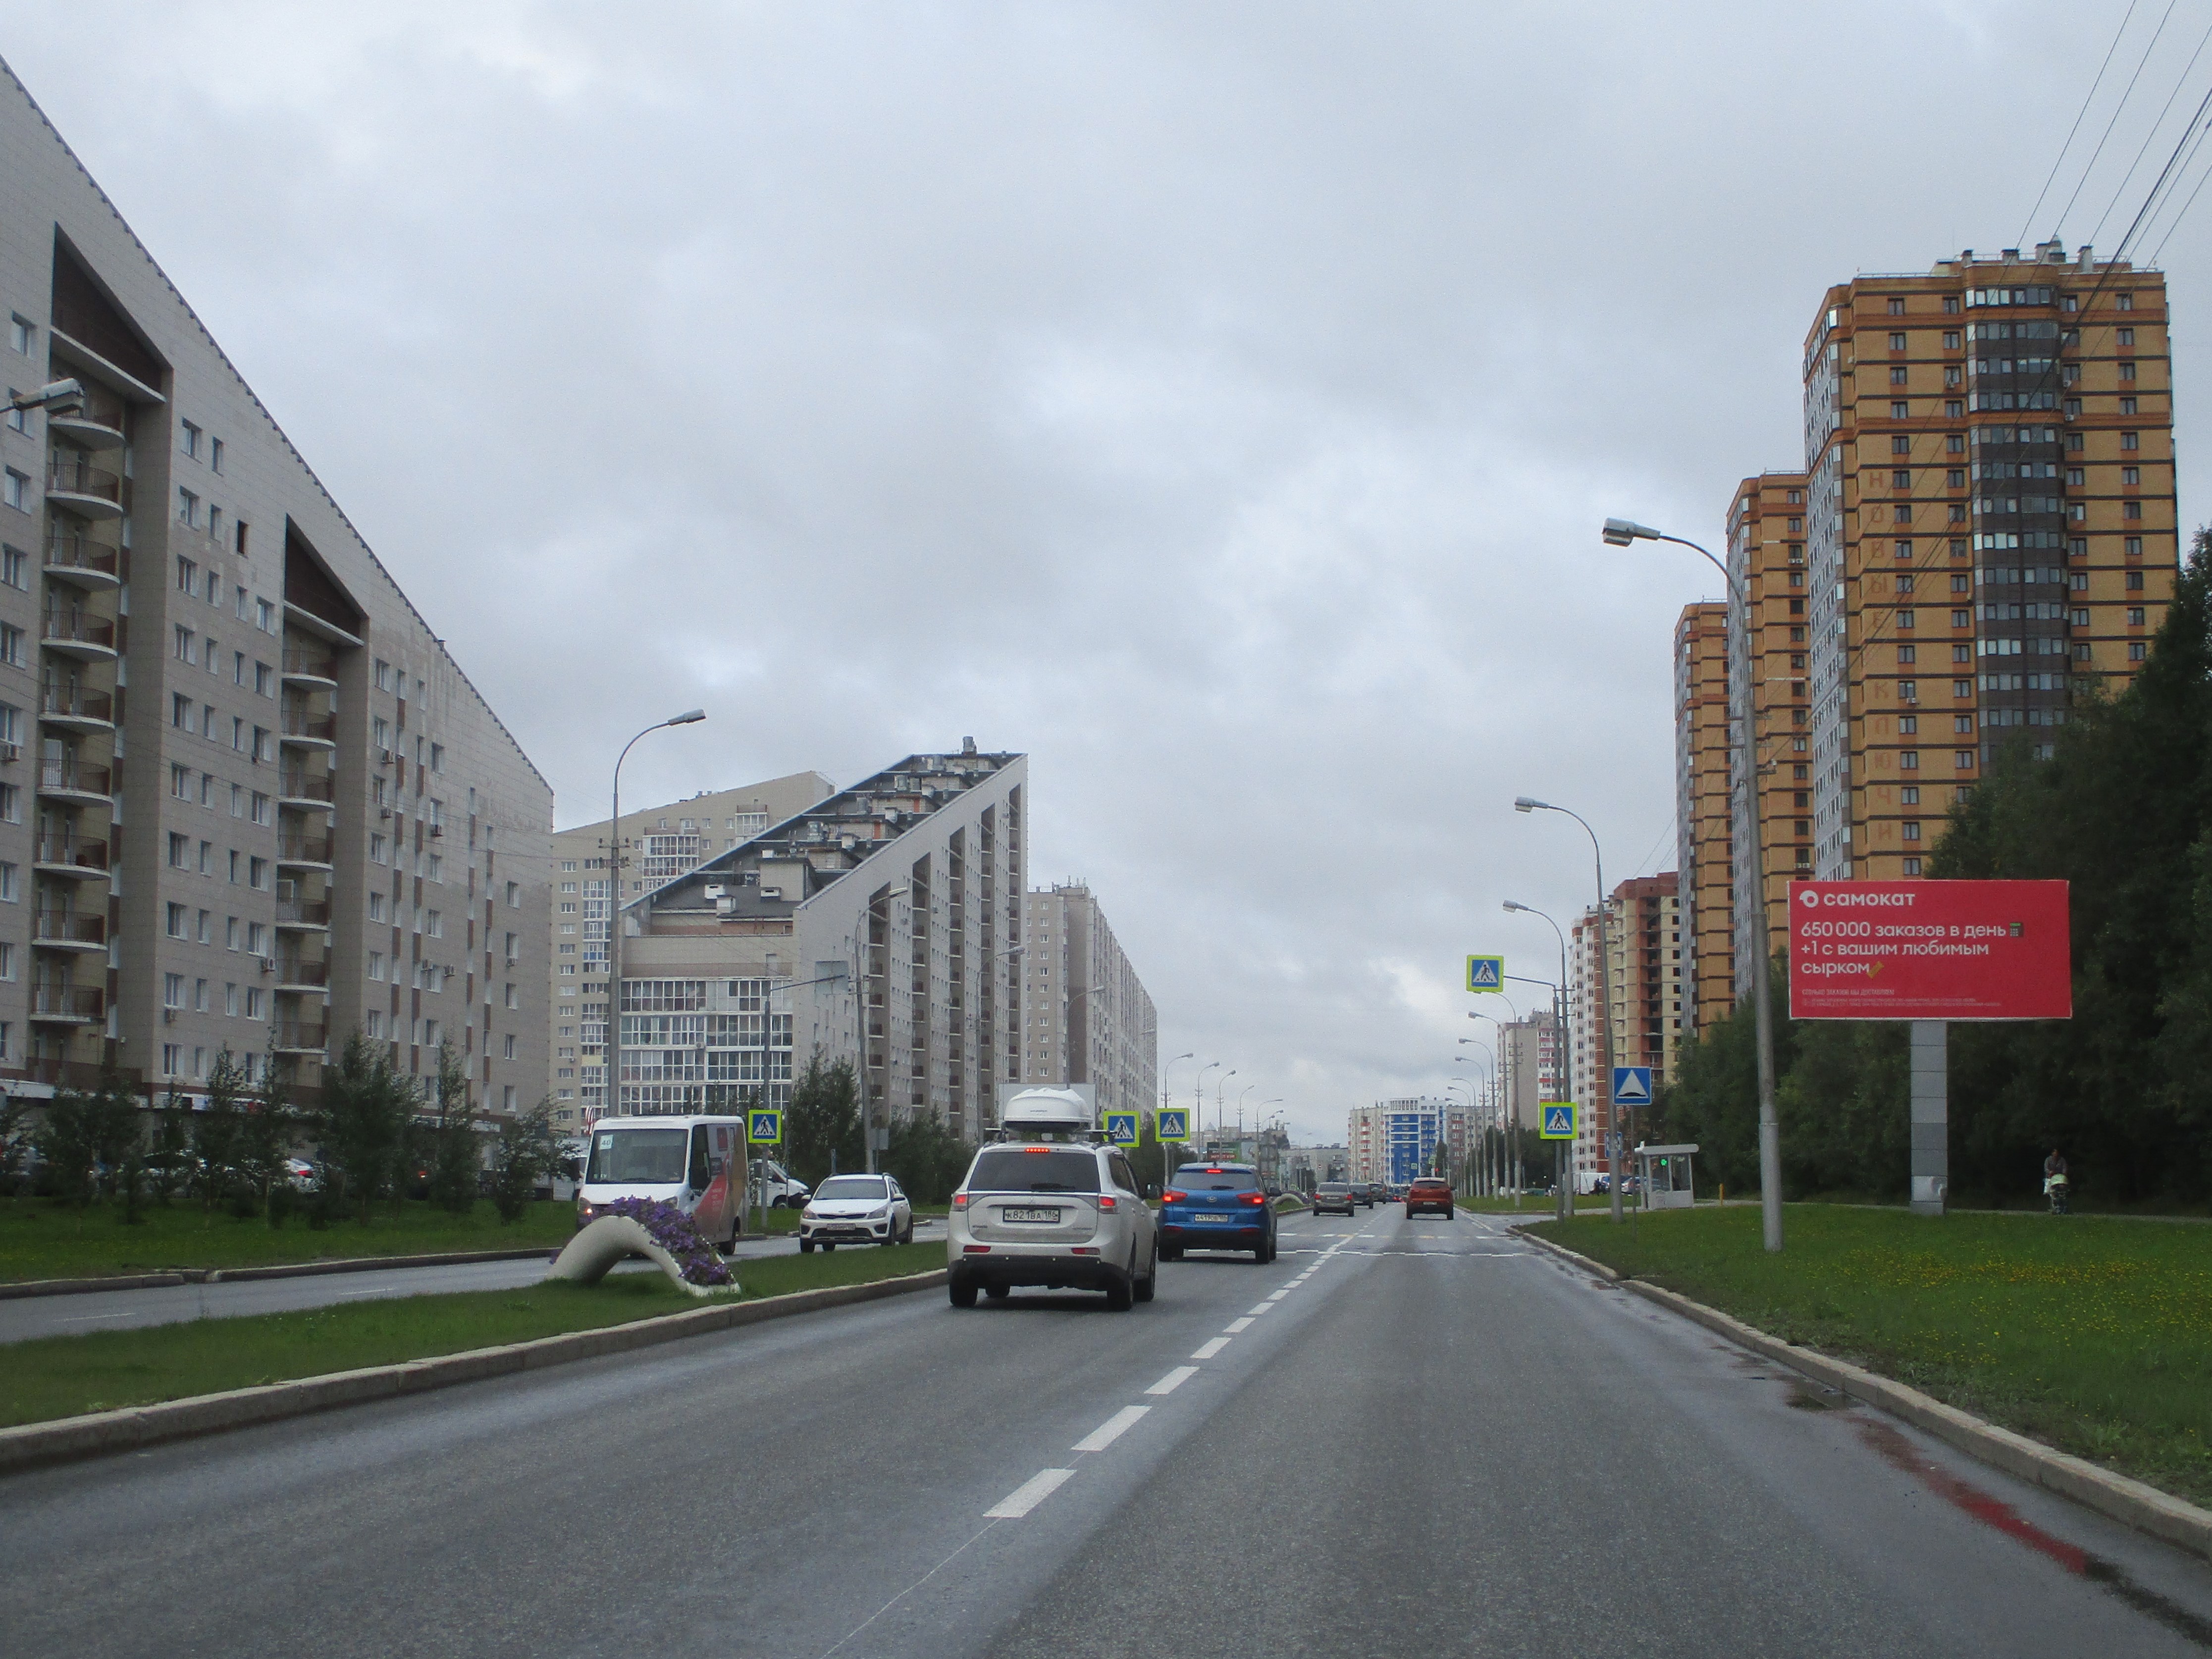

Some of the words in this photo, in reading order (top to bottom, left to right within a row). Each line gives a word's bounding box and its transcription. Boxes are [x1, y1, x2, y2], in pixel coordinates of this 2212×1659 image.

[1824, 893, 1916, 907] самокат
[1875, 926, 1946, 937] заказов
[1950, 926, 1960, 937] в
[1964, 926, 2006, 939] день
[1801, 941, 1818, 955] +1
[1822, 944, 1833, 956] с
[1838, 944, 1898, 956] вашим
[1902, 940, 1990, 956] любимым
[1801, 963, 1869, 977] сырком
